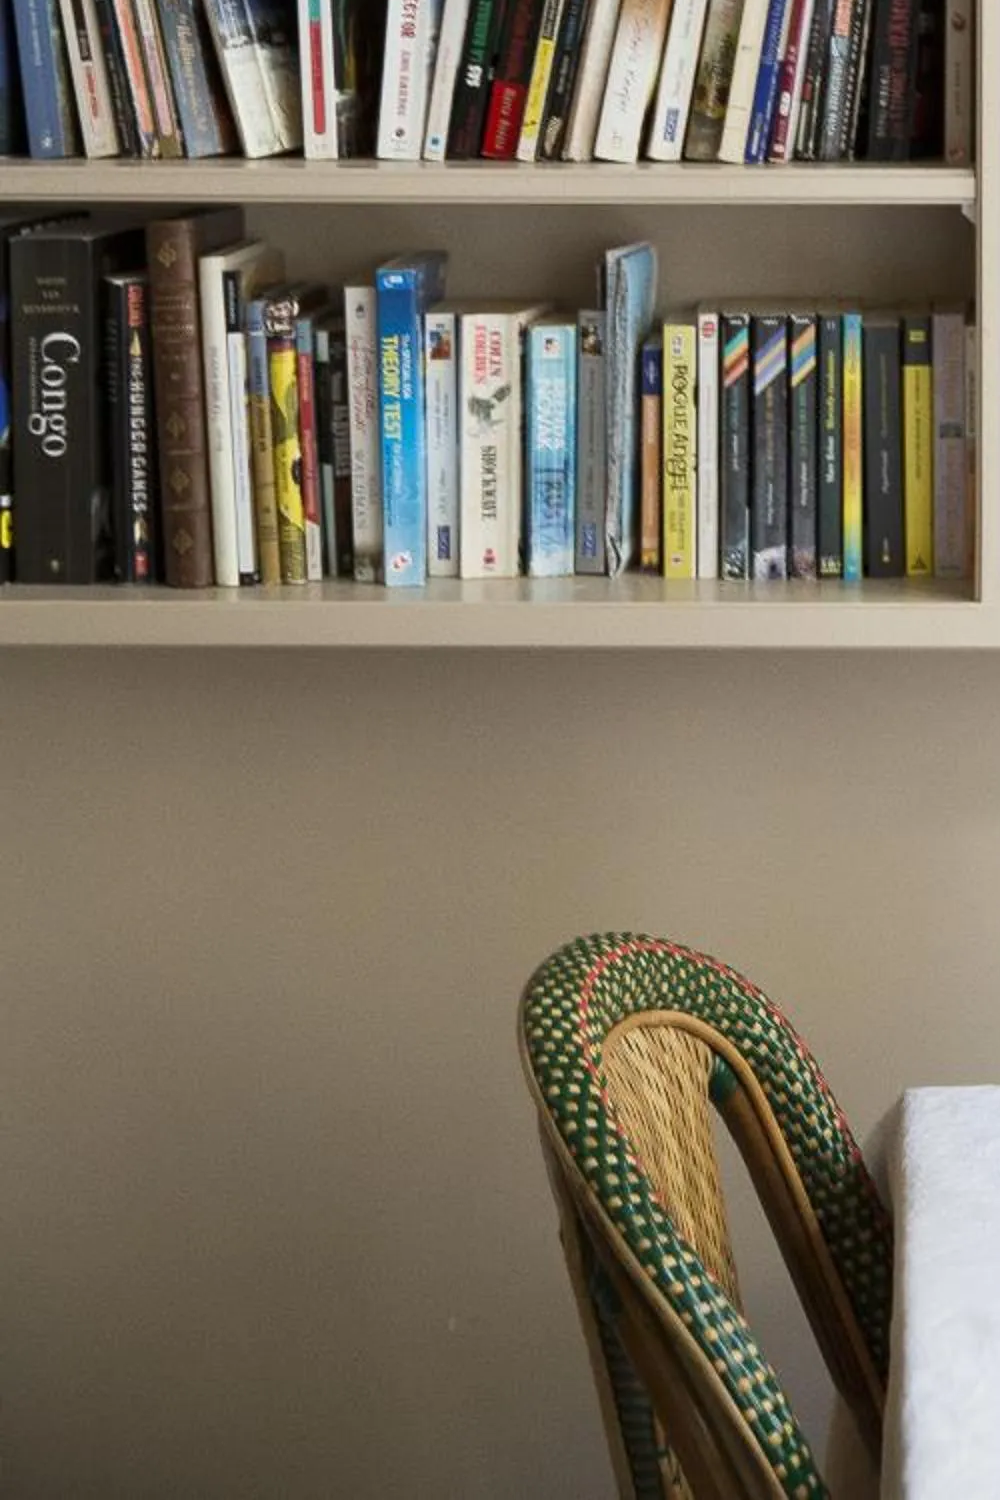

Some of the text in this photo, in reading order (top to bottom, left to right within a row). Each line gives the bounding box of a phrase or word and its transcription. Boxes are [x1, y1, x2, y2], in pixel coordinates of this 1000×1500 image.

[381, 334, 400, 397] THEORY
[488, 330, 502, 378] COLIN
[29, 331, 81, 458] Congo
[129, 381, 147, 451] HUNGER
[384, 403, 402, 442] TEST
[671, 364, 689, 429] ROGUE
[131, 457, 147, 512] GAMES
[481, 445, 497, 521] SHOCKWAVE
